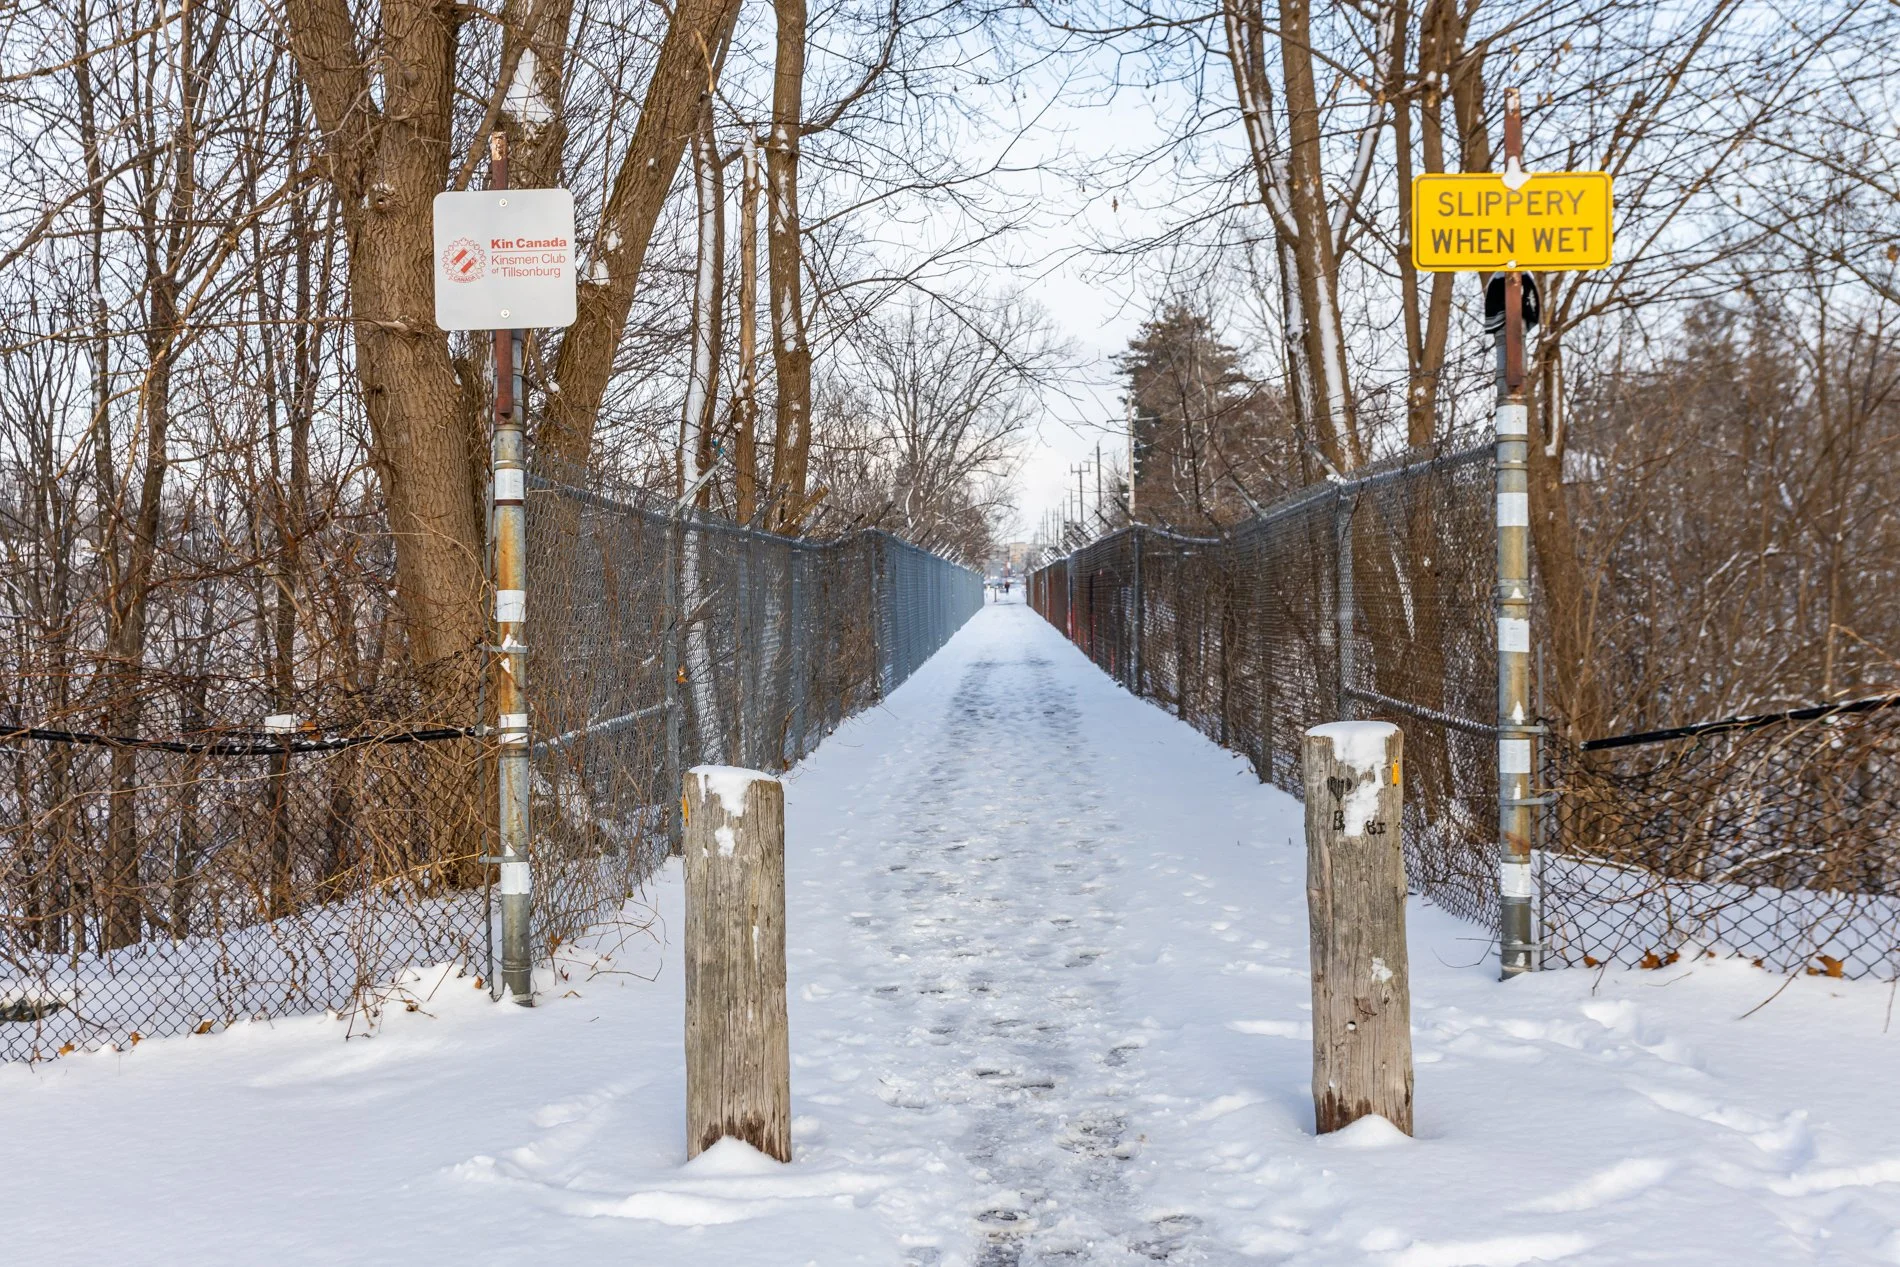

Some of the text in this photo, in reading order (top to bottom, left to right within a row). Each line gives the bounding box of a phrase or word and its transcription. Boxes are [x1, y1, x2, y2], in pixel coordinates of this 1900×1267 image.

[1438, 190, 1585, 216] SLIPPERY
[491, 237, 567, 249] Kin Canada
[1431, 227, 1593, 254] WHEN WET
[491, 253, 566, 265] Kinsmen Club
[501, 266, 561, 278] Tillsonburg
